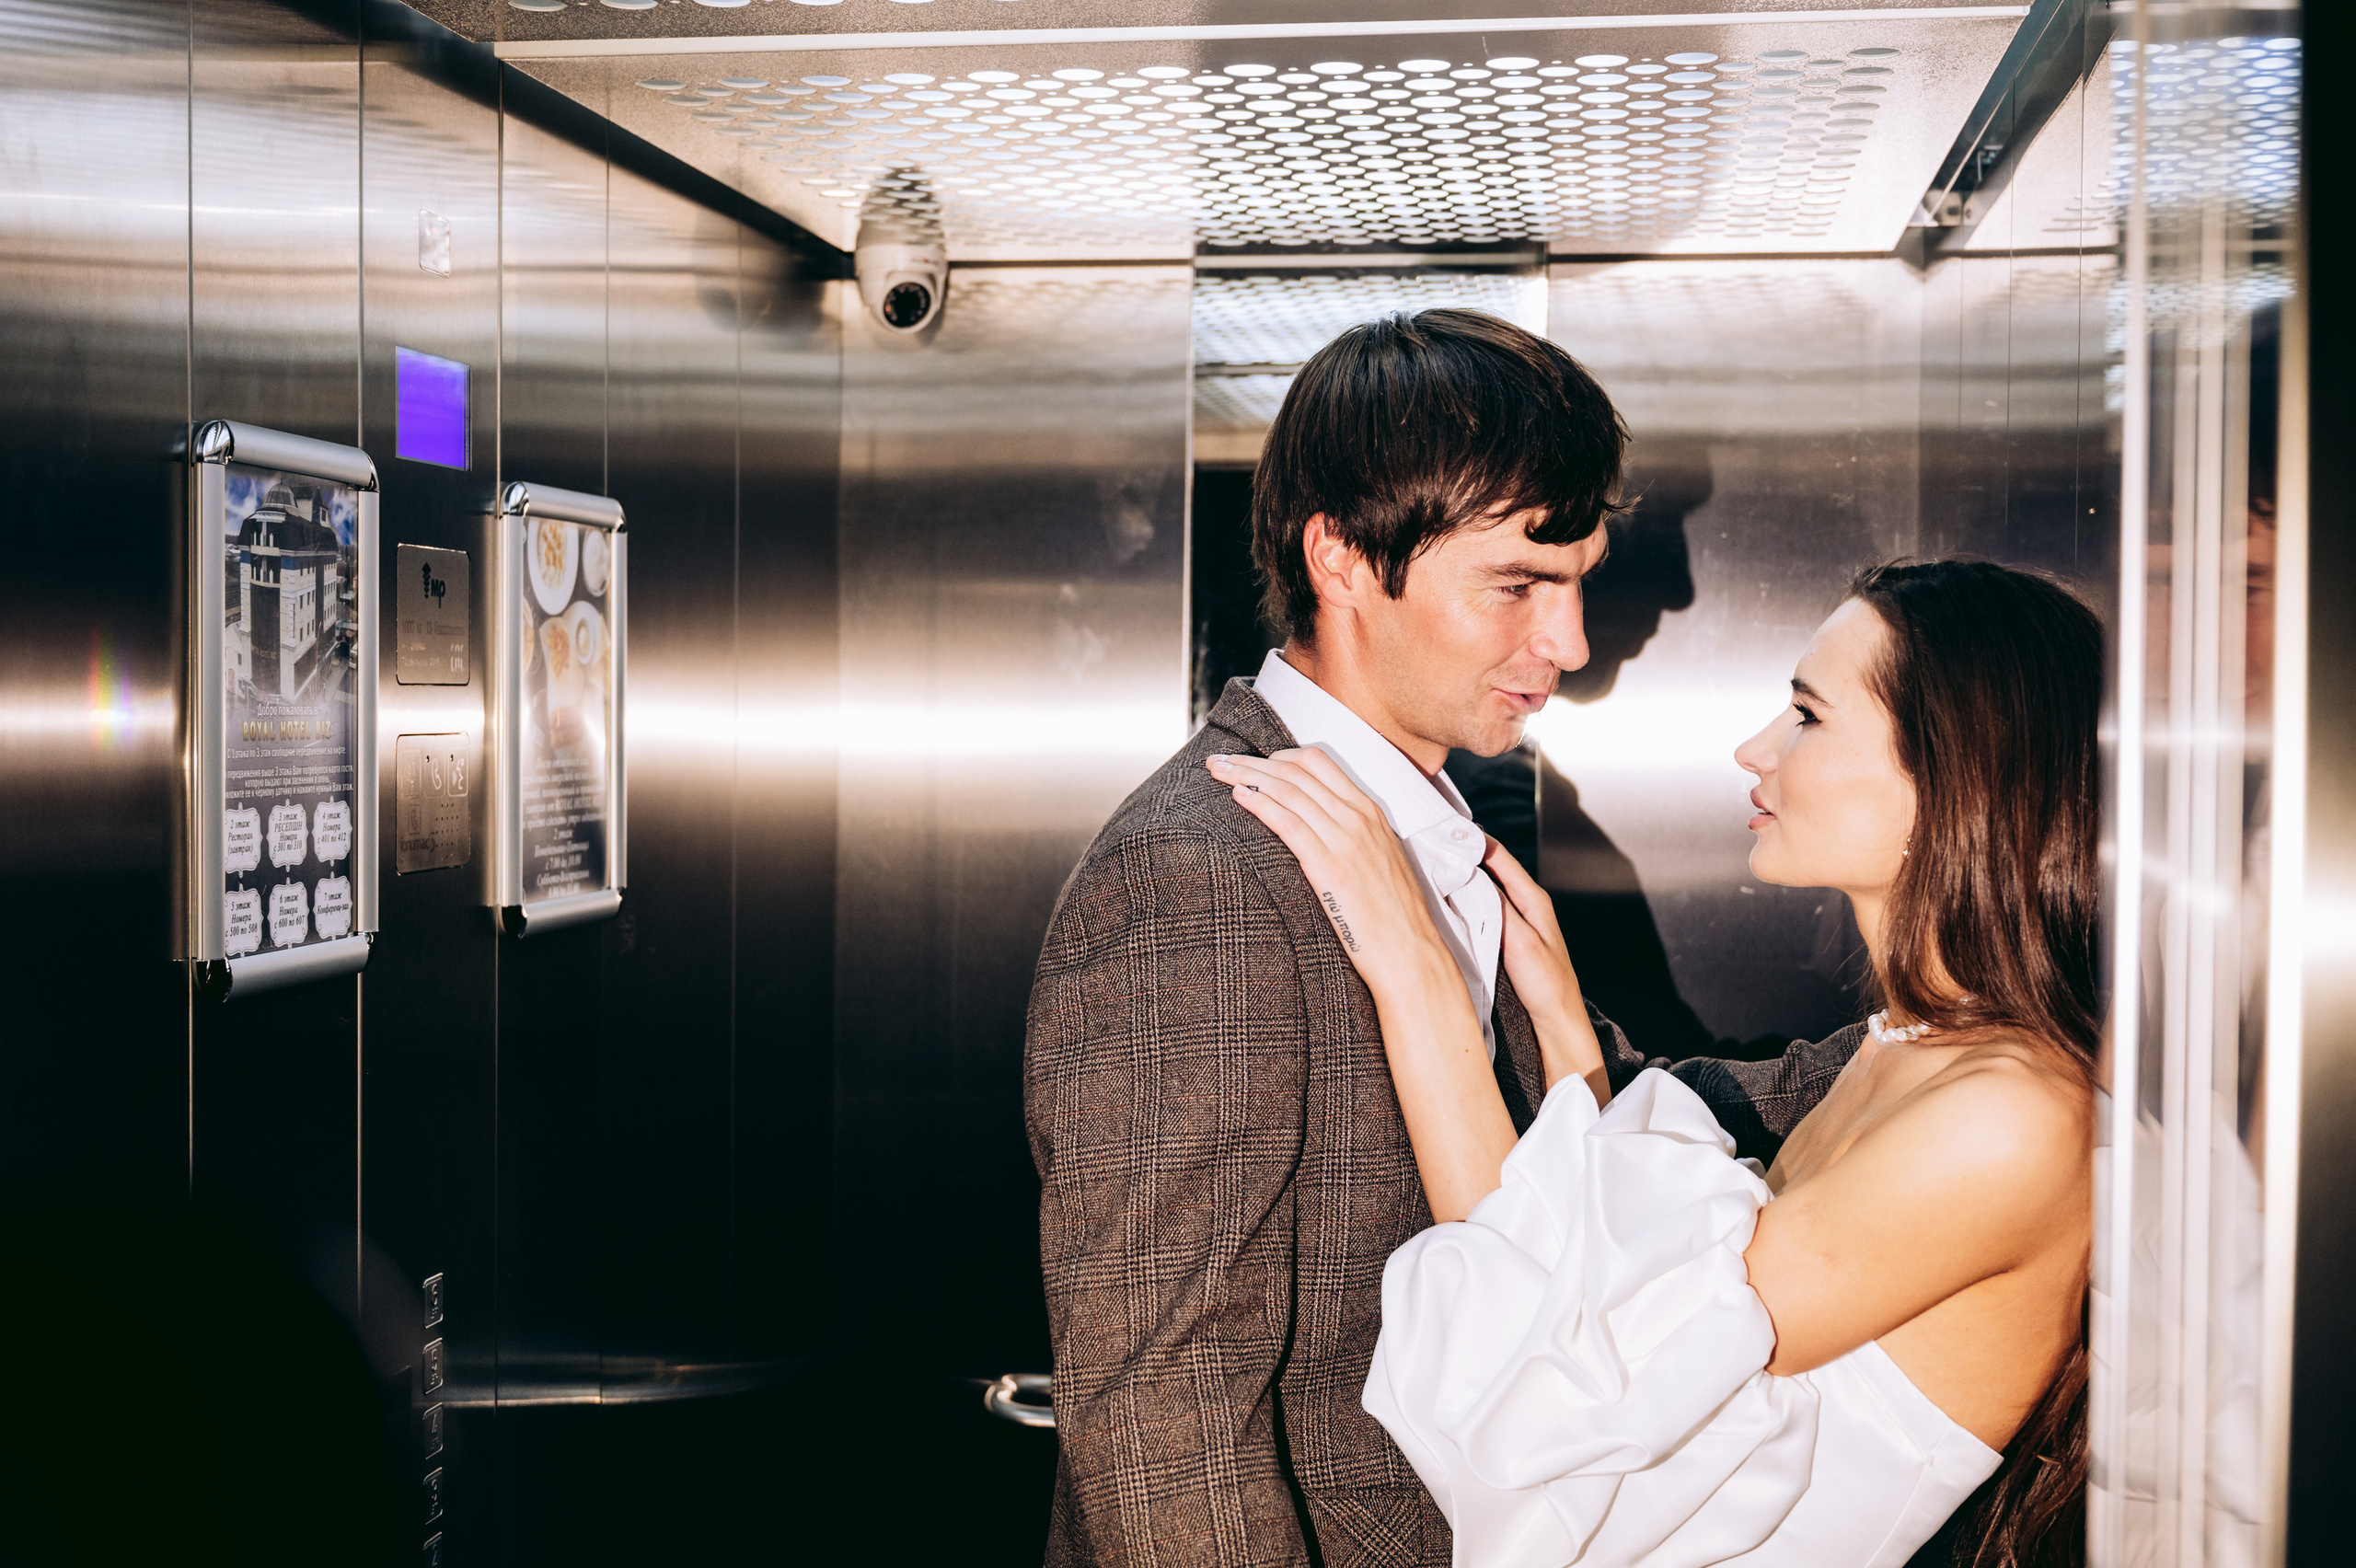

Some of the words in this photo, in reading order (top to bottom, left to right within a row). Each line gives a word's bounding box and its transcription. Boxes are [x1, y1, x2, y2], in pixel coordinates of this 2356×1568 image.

[258, 702, 277, 717] Добро
[278, 705, 313, 717] пожаловать
[243, 721, 275, 741] ROYAL
[280, 721, 311, 741] HOTEL
[316, 721, 331, 740] RIZ
[236, 750, 248, 758] этажа
[256, 747, 260, 758] 3
[260, 749, 271, 758] этаж
[275, 766, 279, 777] 3
[279, 767, 292, 776] этажа
[329, 766, 341, 776] карта
[245, 779, 263, 789] которую
[279, 813, 282, 822] 3
[283, 813, 298, 821] этаж
[322, 812, 326, 820] 4
[327, 812, 341, 820] этаж
[230, 820, 234, 829] 2
[236, 820, 250, 829] этаж
[323, 823, 341, 834] Номера
[228, 832, 253, 844] Ресторан
[280, 832, 297, 845] Номера
[321, 834, 330, 844] 401
[338, 832, 347, 842] 412
[554, 829, 558, 839] 2
[228, 844, 253, 856] (завтрак)
[278, 843, 286, 852] 301
[294, 840, 303, 850] 310
[280, 894, 283, 904] 6
[283, 894, 298, 903] этаж
[325, 893, 327, 901] 7
[328, 893, 342, 901] этаж
[231, 902, 235, 912] 5
[236, 902, 251, 911] этаж
[279, 905, 298, 917] Номера
[318, 903, 350, 915] Конференц-зал
[232, 914, 251, 925] Номера
[279, 917, 287, 928] 600
[295, 915, 306, 926] 607
[230, 927, 239, 937] 500
[248, 923, 258, 934] 508
